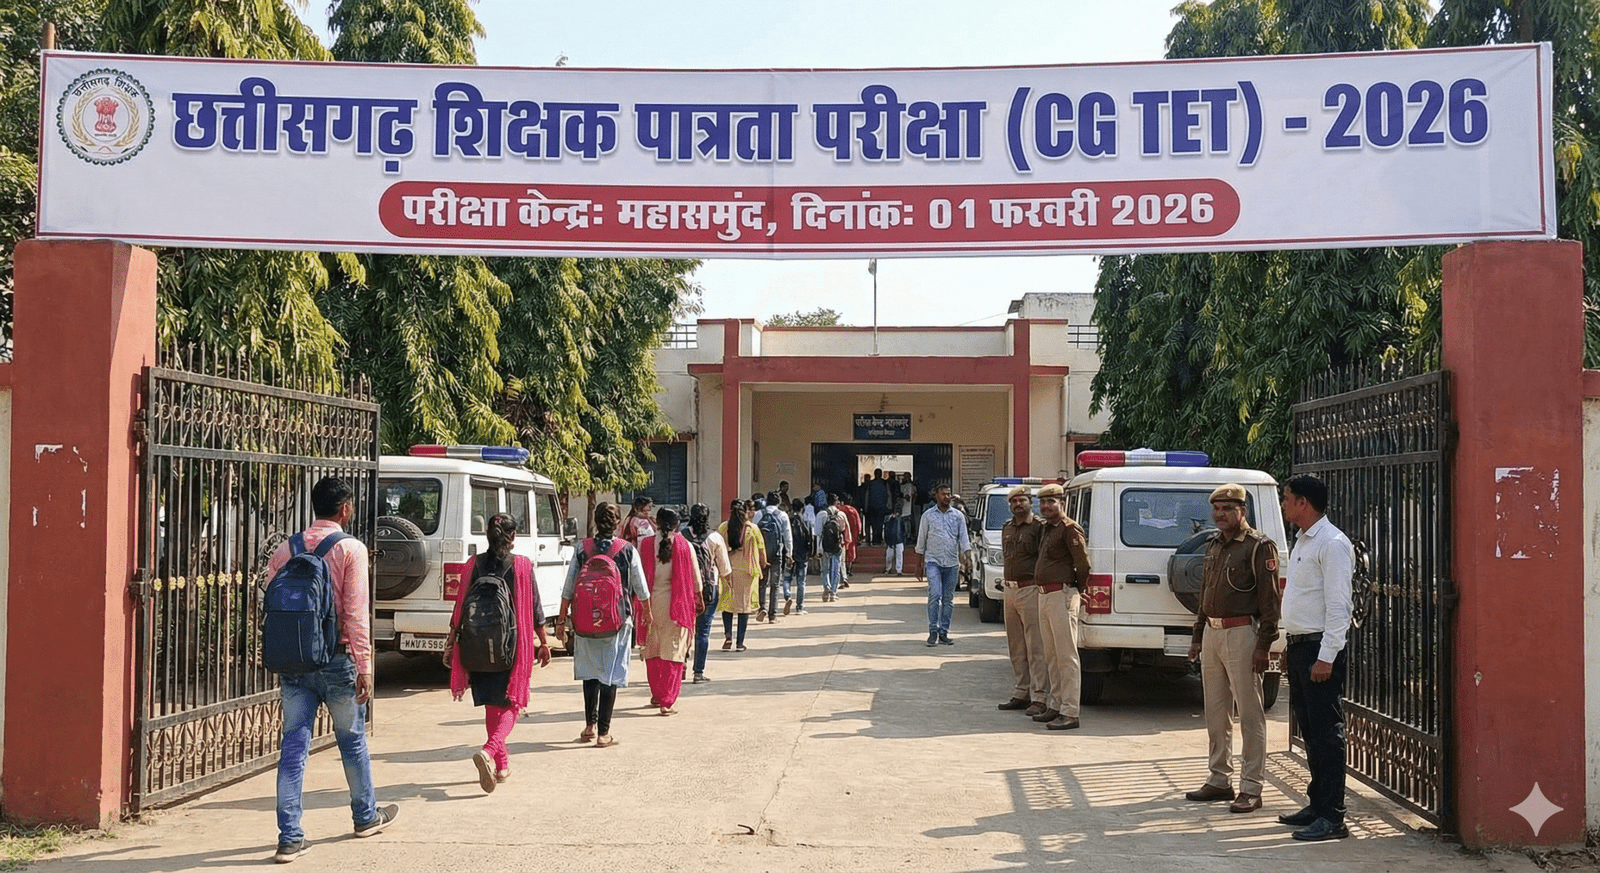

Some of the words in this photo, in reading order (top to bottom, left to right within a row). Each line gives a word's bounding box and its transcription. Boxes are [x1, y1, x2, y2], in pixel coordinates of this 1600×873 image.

[172, 77, 419, 174] छत्तीसगढ़
[433, 82, 620, 161] शिक्षक
[635, 103, 800, 162] पात्रता
[813, 85, 988, 162] परीक्षा
[1008, 87, 1117, 173] (CG
[1133, 81, 1264, 166] TET)
[1286, 117, 1308, 130] -
[1325, 78, 1489, 150] 2026
[402, 187, 510, 227] परीक्षा
[616, 191, 777, 241] महासमुंद,
[929, 199, 975, 229] 01
[988, 188, 1100, 228] फरवरी
[1111, 192, 1214, 226] 2026
